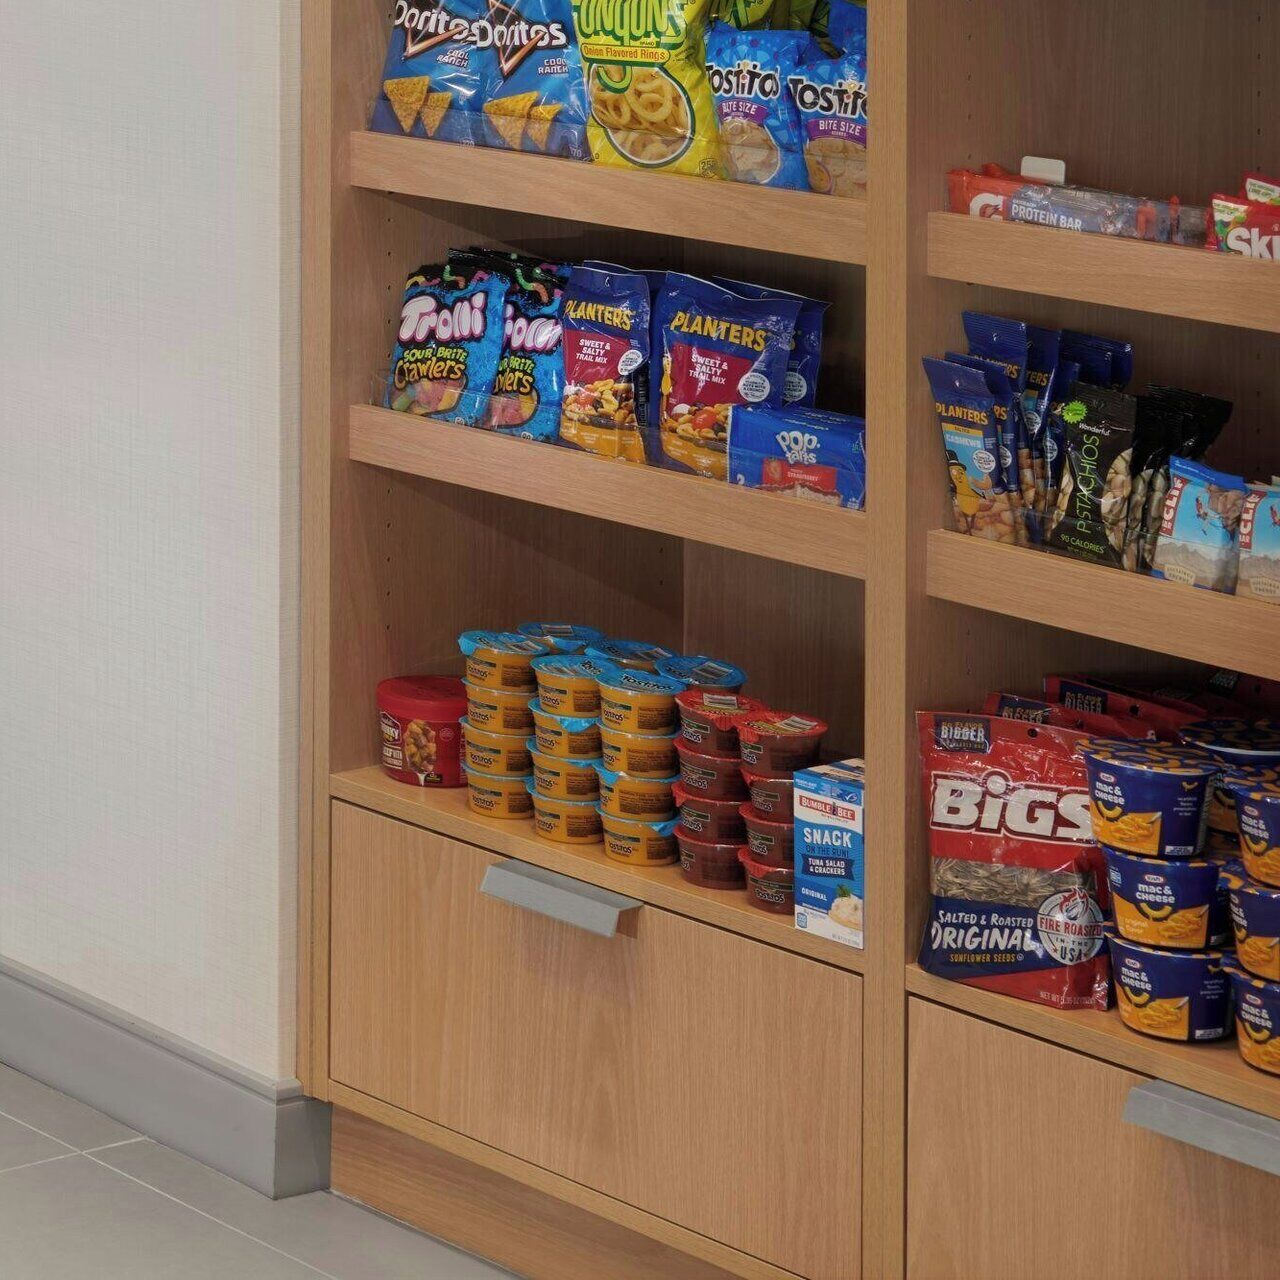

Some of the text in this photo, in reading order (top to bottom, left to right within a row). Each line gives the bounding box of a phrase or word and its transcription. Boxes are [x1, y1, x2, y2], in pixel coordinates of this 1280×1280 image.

[476, 19, 568, 48] Doritos
[447, 49, 469, 60] COOL
[583, 46, 666, 61] Onion Flavored Rings
[538, 66, 569, 75] RANCH
[819, 120, 862, 136] BITE SIZE
[1011, 204, 1084, 232] PROTEIN BAR
[399, 292, 486, 343] Trolli
[670, 310, 767, 352] PLANTERS
[403, 348, 468, 362] SOUR BRITE
[583, 346, 606, 357] SALTY
[690, 353, 729, 370] SWEET &
[394, 360, 466, 389] Crawlers
[688, 369, 726, 385] TRAIL MIX
[935, 402, 989, 426] PLANTERS
[1075, 433, 1100, 534] PISTACHIOS
[941, 723, 986, 742] BIGGER
[801, 797, 853, 819] BUMBLE BEE
[803, 827, 852, 848] SNACK
[808, 858, 845, 868] TUNA SALAD
[801, 887, 828, 902] ORIGINAL
[1138, 883, 1172, 896] mac &
[939, 911, 1034, 928] SALTED & ROASTED
[1040, 917, 1103, 937] FIRE ROASTED
[949, 952, 1016, 963] SUNFLOWER SEEDS
[1060, 945, 1083, 962] USA
